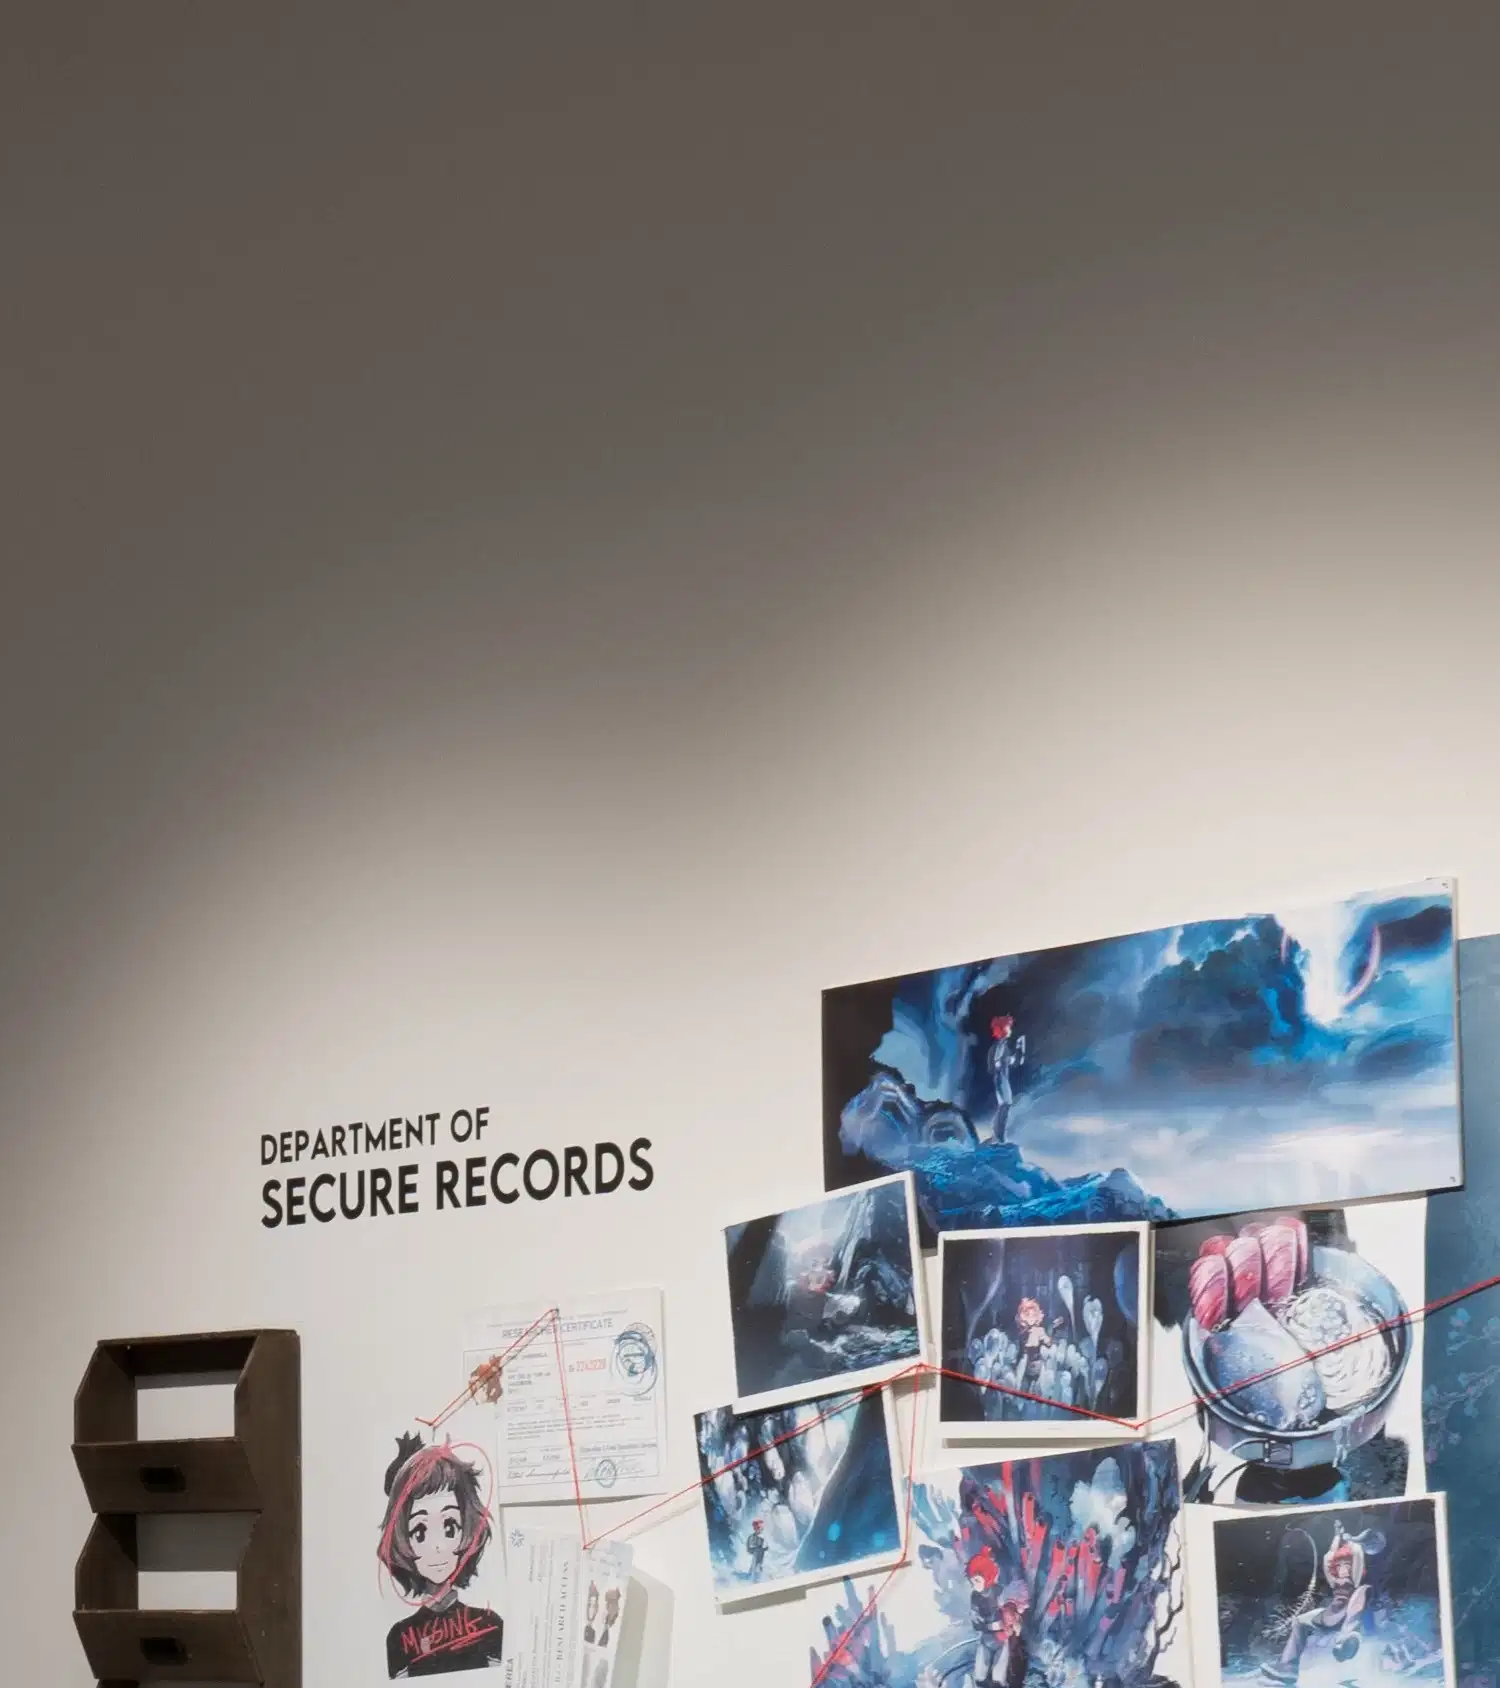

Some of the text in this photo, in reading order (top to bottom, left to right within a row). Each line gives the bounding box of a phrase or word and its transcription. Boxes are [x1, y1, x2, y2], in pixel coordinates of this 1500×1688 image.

[261, 1106, 490, 1165] DEPARTMENT OF
[261, 1137, 654, 1229] SECURE RECORDS
[560, 1317, 614, 1334] CERTIFICATE
